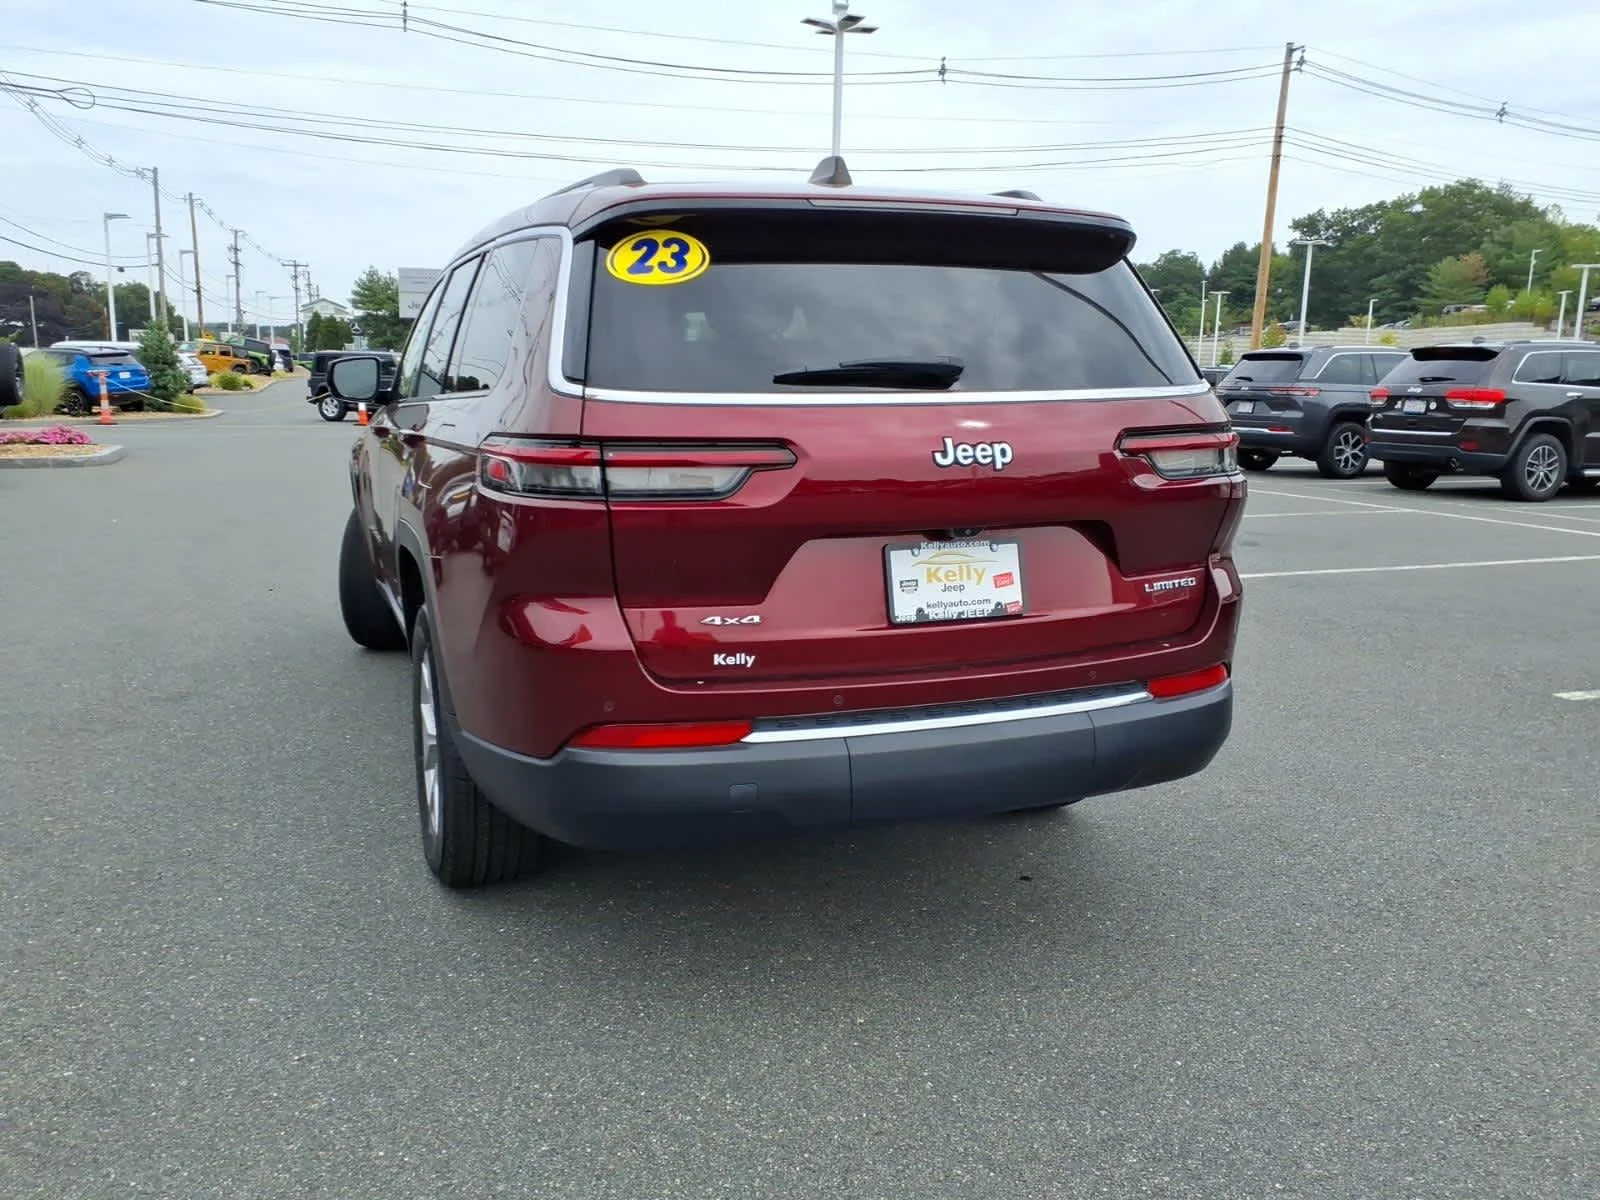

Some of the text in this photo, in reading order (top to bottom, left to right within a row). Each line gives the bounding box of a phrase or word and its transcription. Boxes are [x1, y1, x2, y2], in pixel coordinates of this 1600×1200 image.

[627, 237, 690, 275] 23
[932, 436, 1013, 471] Jeep
[920, 540, 990, 550] Kellyauto.com
[926, 564, 986, 586] Kelly
[941, 583, 965, 593] Jeep
[1144, 577, 1196, 592] LIMITED
[926, 598, 991, 610] kellyauto.com
[961, 607, 992, 618] JEEP
[700, 615, 761, 625] 4x4
[713, 653, 755, 668] Kelly
